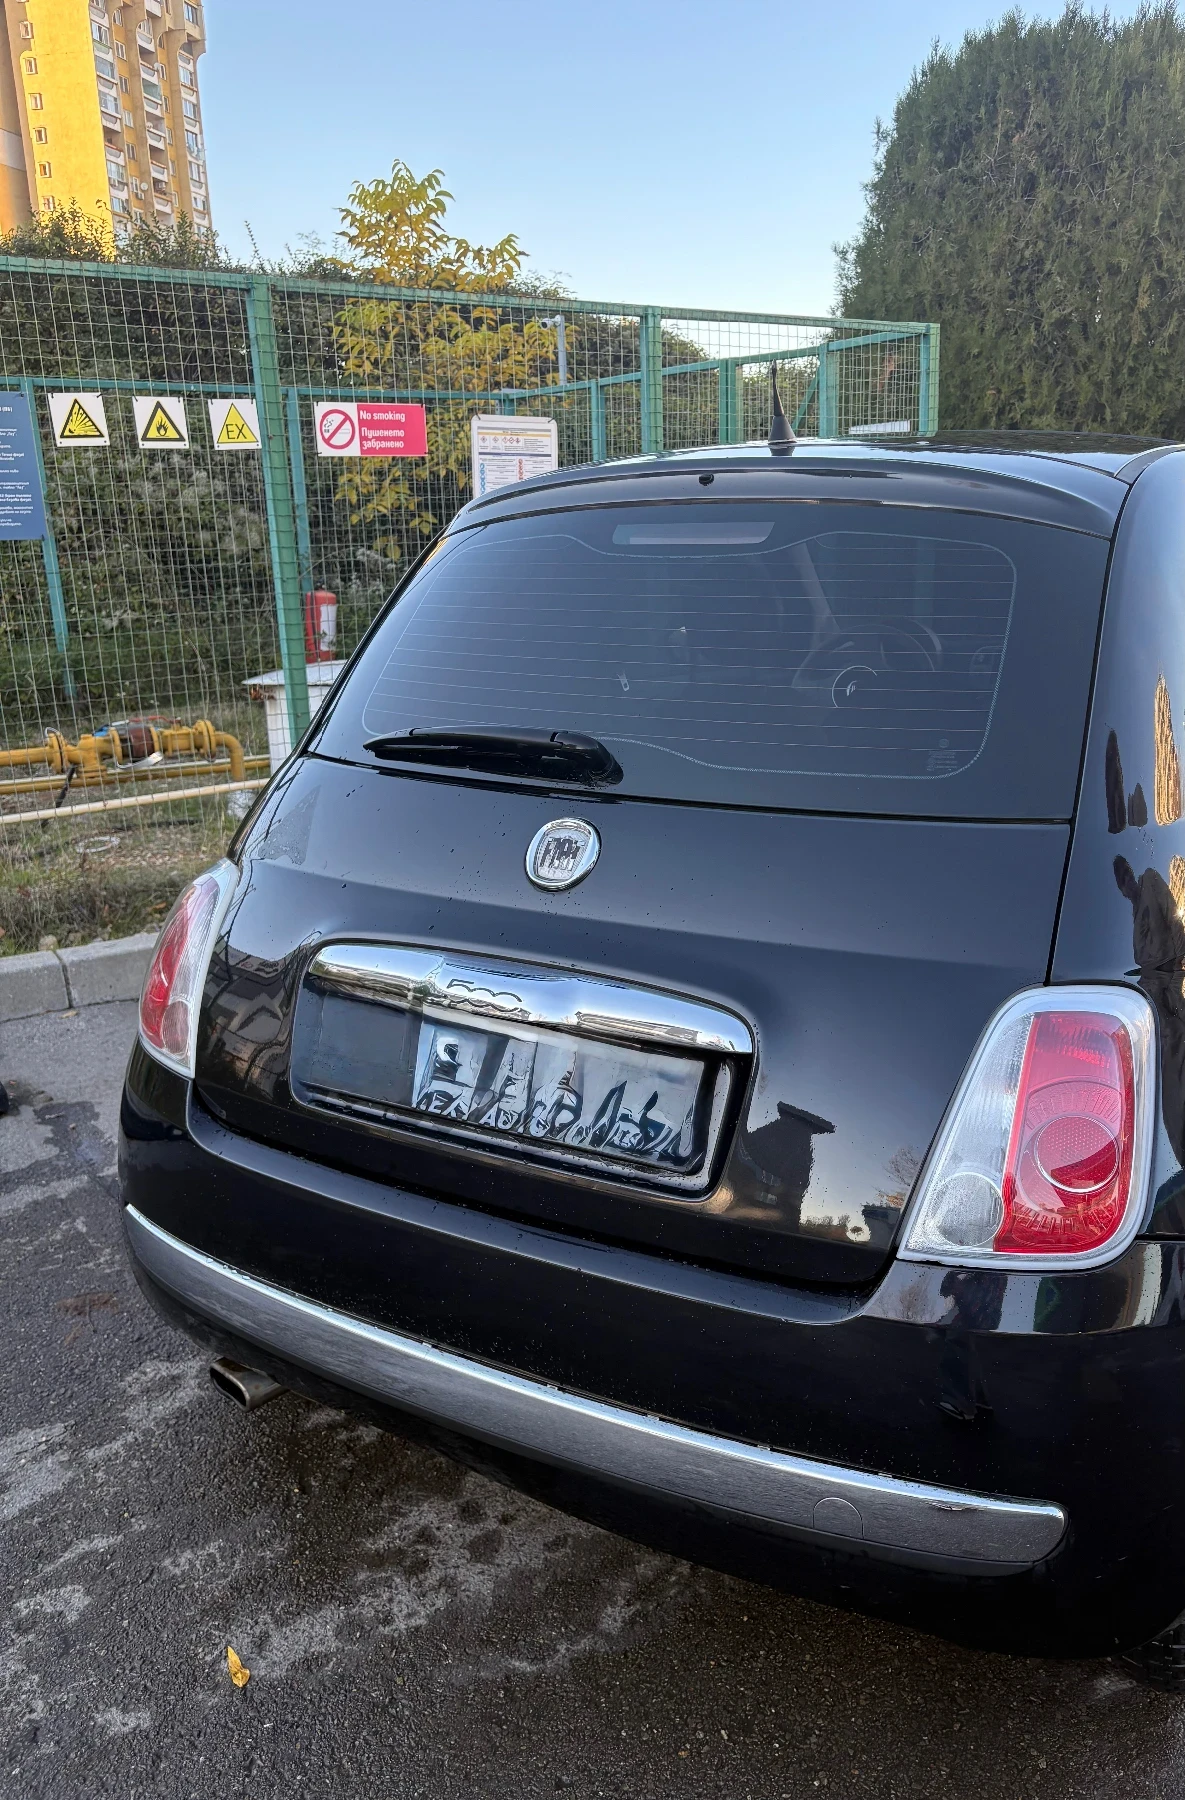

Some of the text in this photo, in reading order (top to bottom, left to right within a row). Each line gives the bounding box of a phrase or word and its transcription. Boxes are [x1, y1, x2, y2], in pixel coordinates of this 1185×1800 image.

[359, 410, 406, 423] No smoking
[225, 423, 247, 440] EX
[361, 427, 405, 439] Пушенето
[362, 438, 405, 450] забранено
[446, 978, 522, 1013] 500
